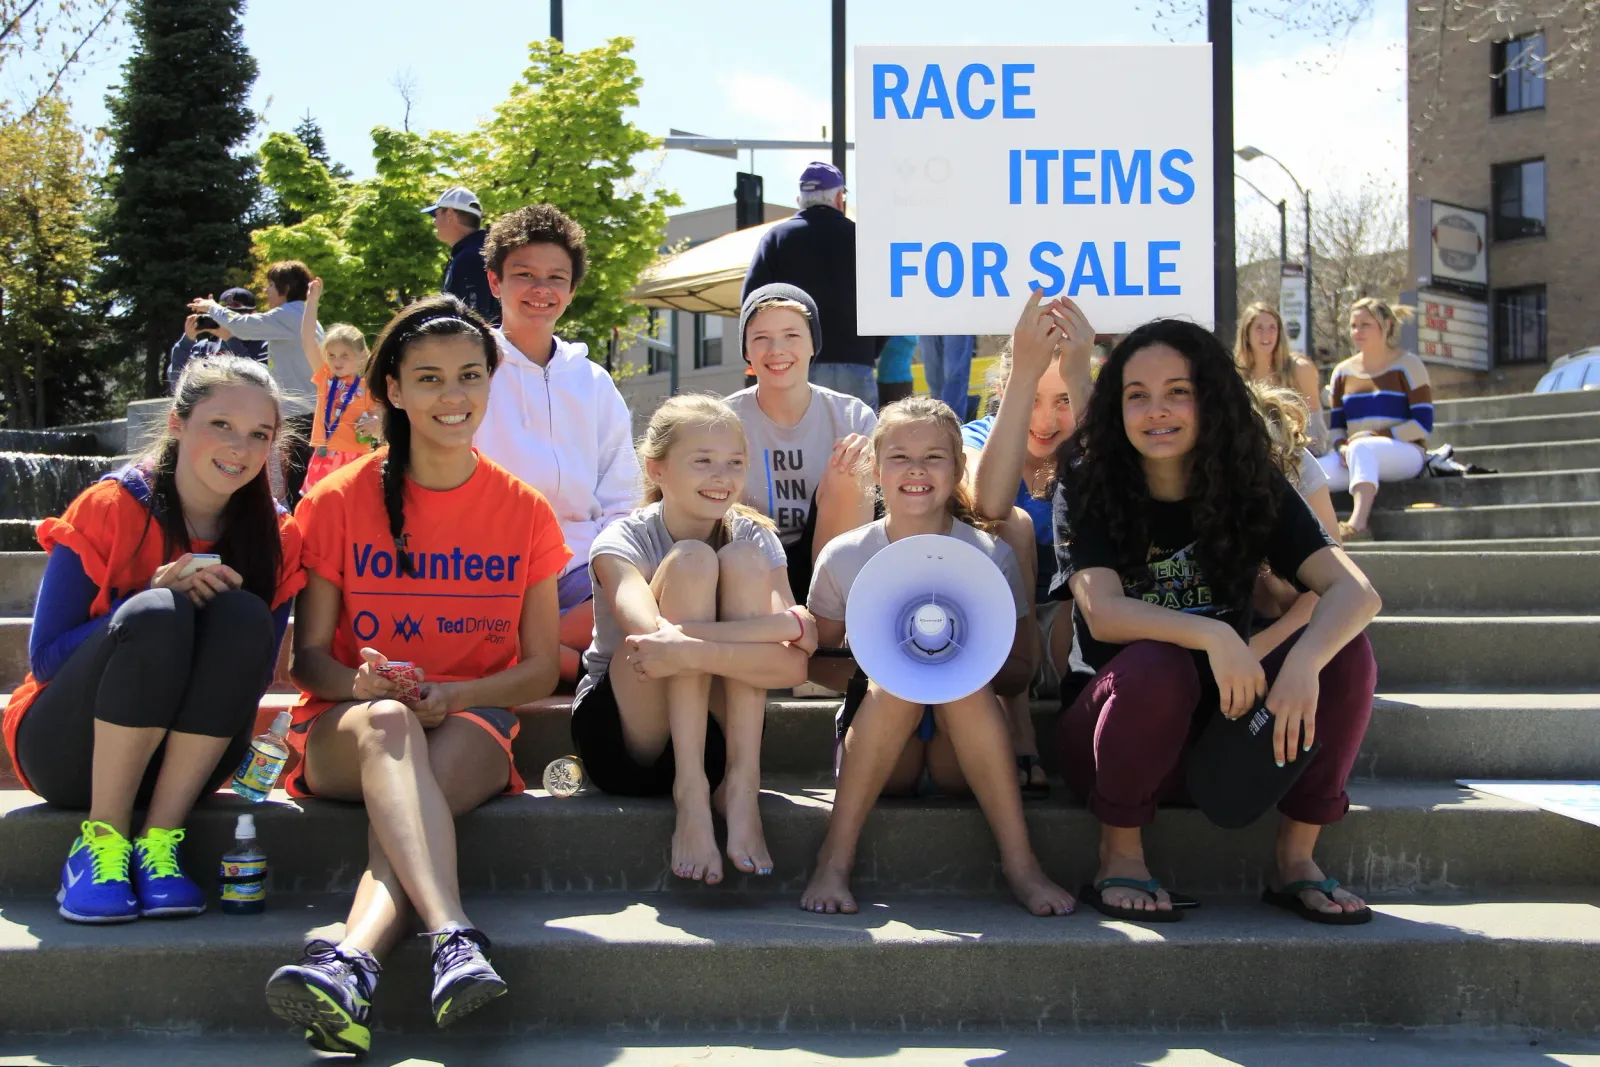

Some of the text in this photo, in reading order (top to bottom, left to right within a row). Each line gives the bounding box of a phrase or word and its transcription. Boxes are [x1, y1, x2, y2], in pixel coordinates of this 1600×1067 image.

[872, 62, 1036, 120] RACE
[1009, 148, 1196, 205] ITEMS
[889, 240, 1181, 298] FOR SALE
[772, 449, 804, 472] RU
[775, 478, 807, 501] NN
[778, 507, 806, 529] ER
